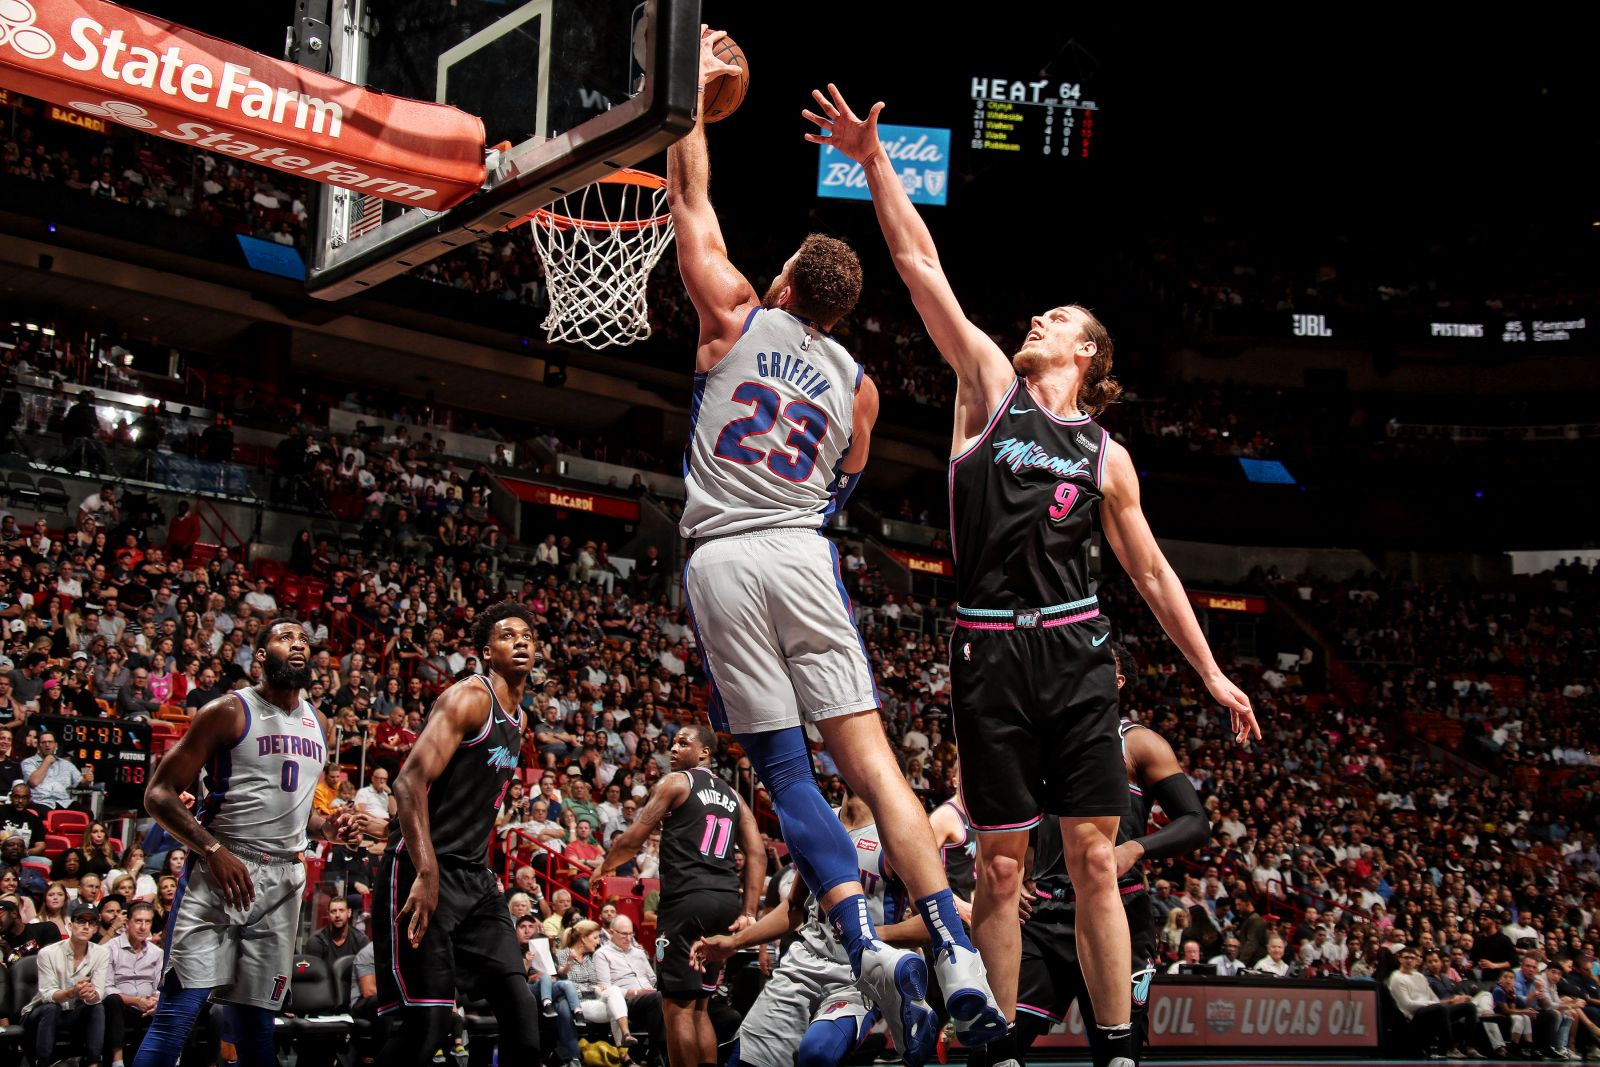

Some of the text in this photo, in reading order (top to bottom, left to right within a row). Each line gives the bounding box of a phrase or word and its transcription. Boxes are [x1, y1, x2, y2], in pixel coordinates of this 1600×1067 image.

[971, 77, 1048, 103] HEAT
[1059, 83, 1081, 100] 64
[1431, 322, 1484, 338] PISTONS
[756, 351, 831, 400] GRIFFIN
[713, 381, 829, 483] 23
[992, 438, 1091, 477] Miami
[1048, 482, 1080, 522] 9
[119, 752, 145, 761] PISTONS
[256, 734, 323, 764] DETROIT
[281, 760, 300, 792] 0
[696, 789, 737, 813] WAITERS
[699, 814, 733, 859] 11
[1153, 997, 1195, 1035] OIL
[1241, 998, 1322, 1036] LUCAS
[1328, 999, 1368, 1036] OIL
